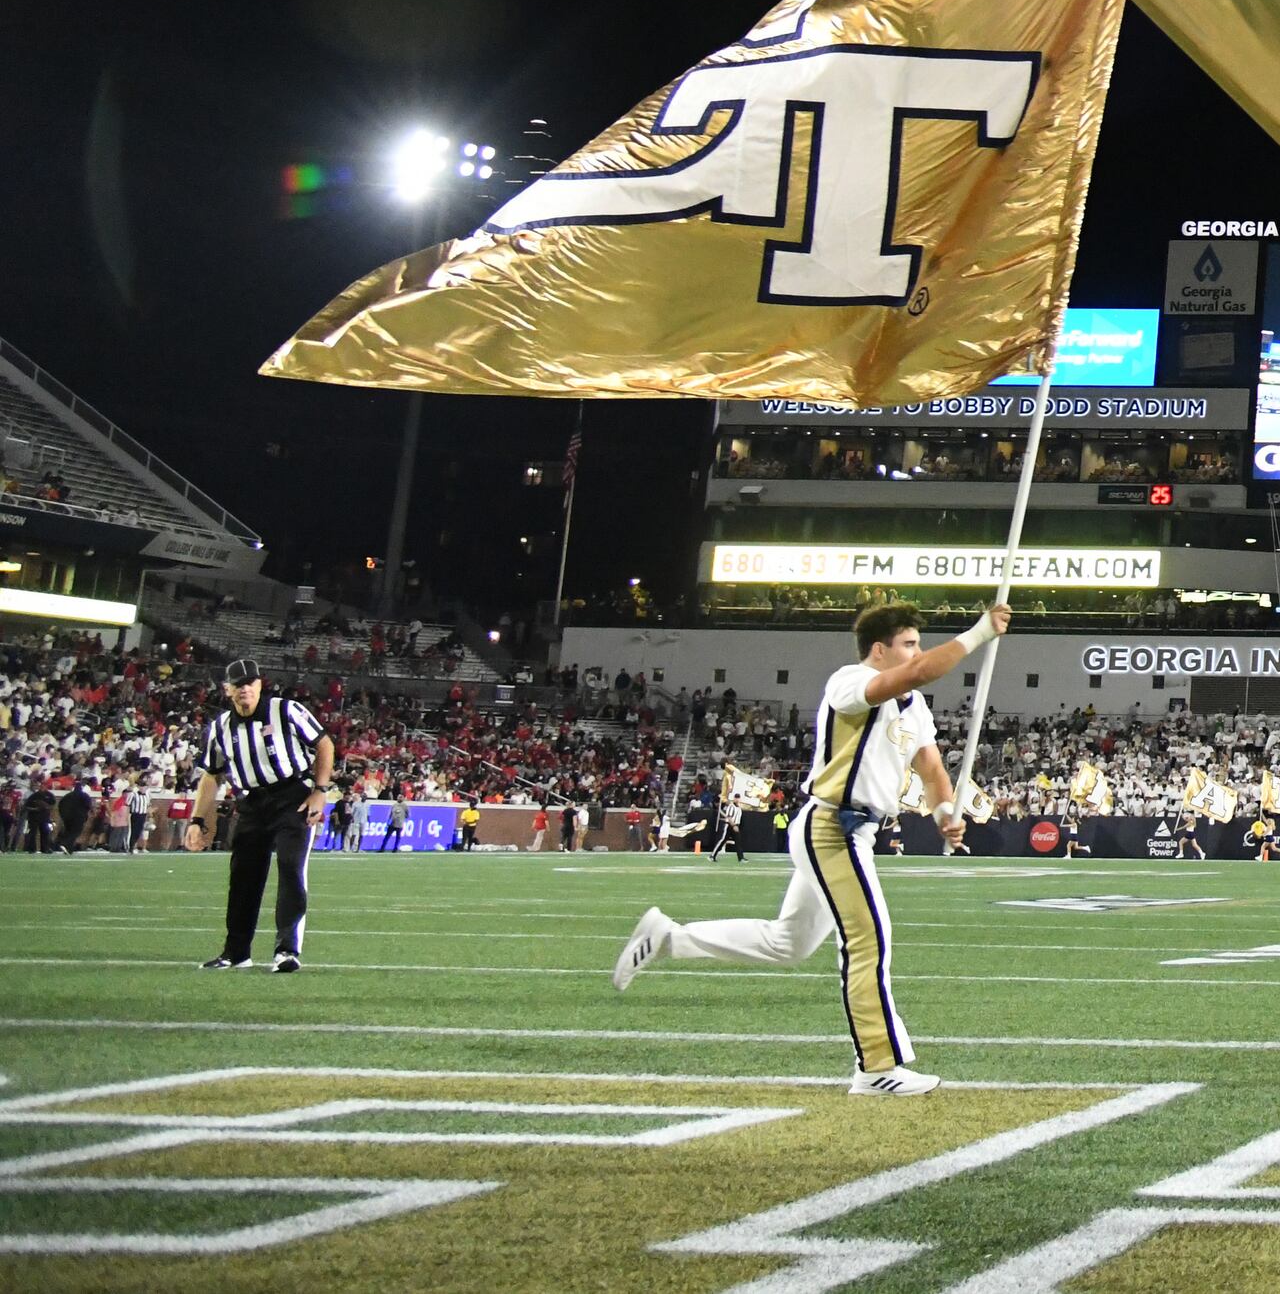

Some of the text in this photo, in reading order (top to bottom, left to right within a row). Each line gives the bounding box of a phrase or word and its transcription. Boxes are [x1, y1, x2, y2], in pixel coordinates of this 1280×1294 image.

[1181, 220, 1279, 237] GEORGIA
[1181, 286, 1233, 300] Georgia
[1169, 300, 1247, 313] Natural Gas
[929, 398, 1012, 415] BOBBY
[1019, 397, 1090, 417] DODD
[1097, 398, 1207, 418] STADIUM
[1150, 486, 1171, 505] 25
[1083, 647, 1240, 672] GEORGIA
[1190, 777, 1227, 818] A
[1147, 838, 1178, 850] Georgia
[1149, 848, 1175, 857] Power
